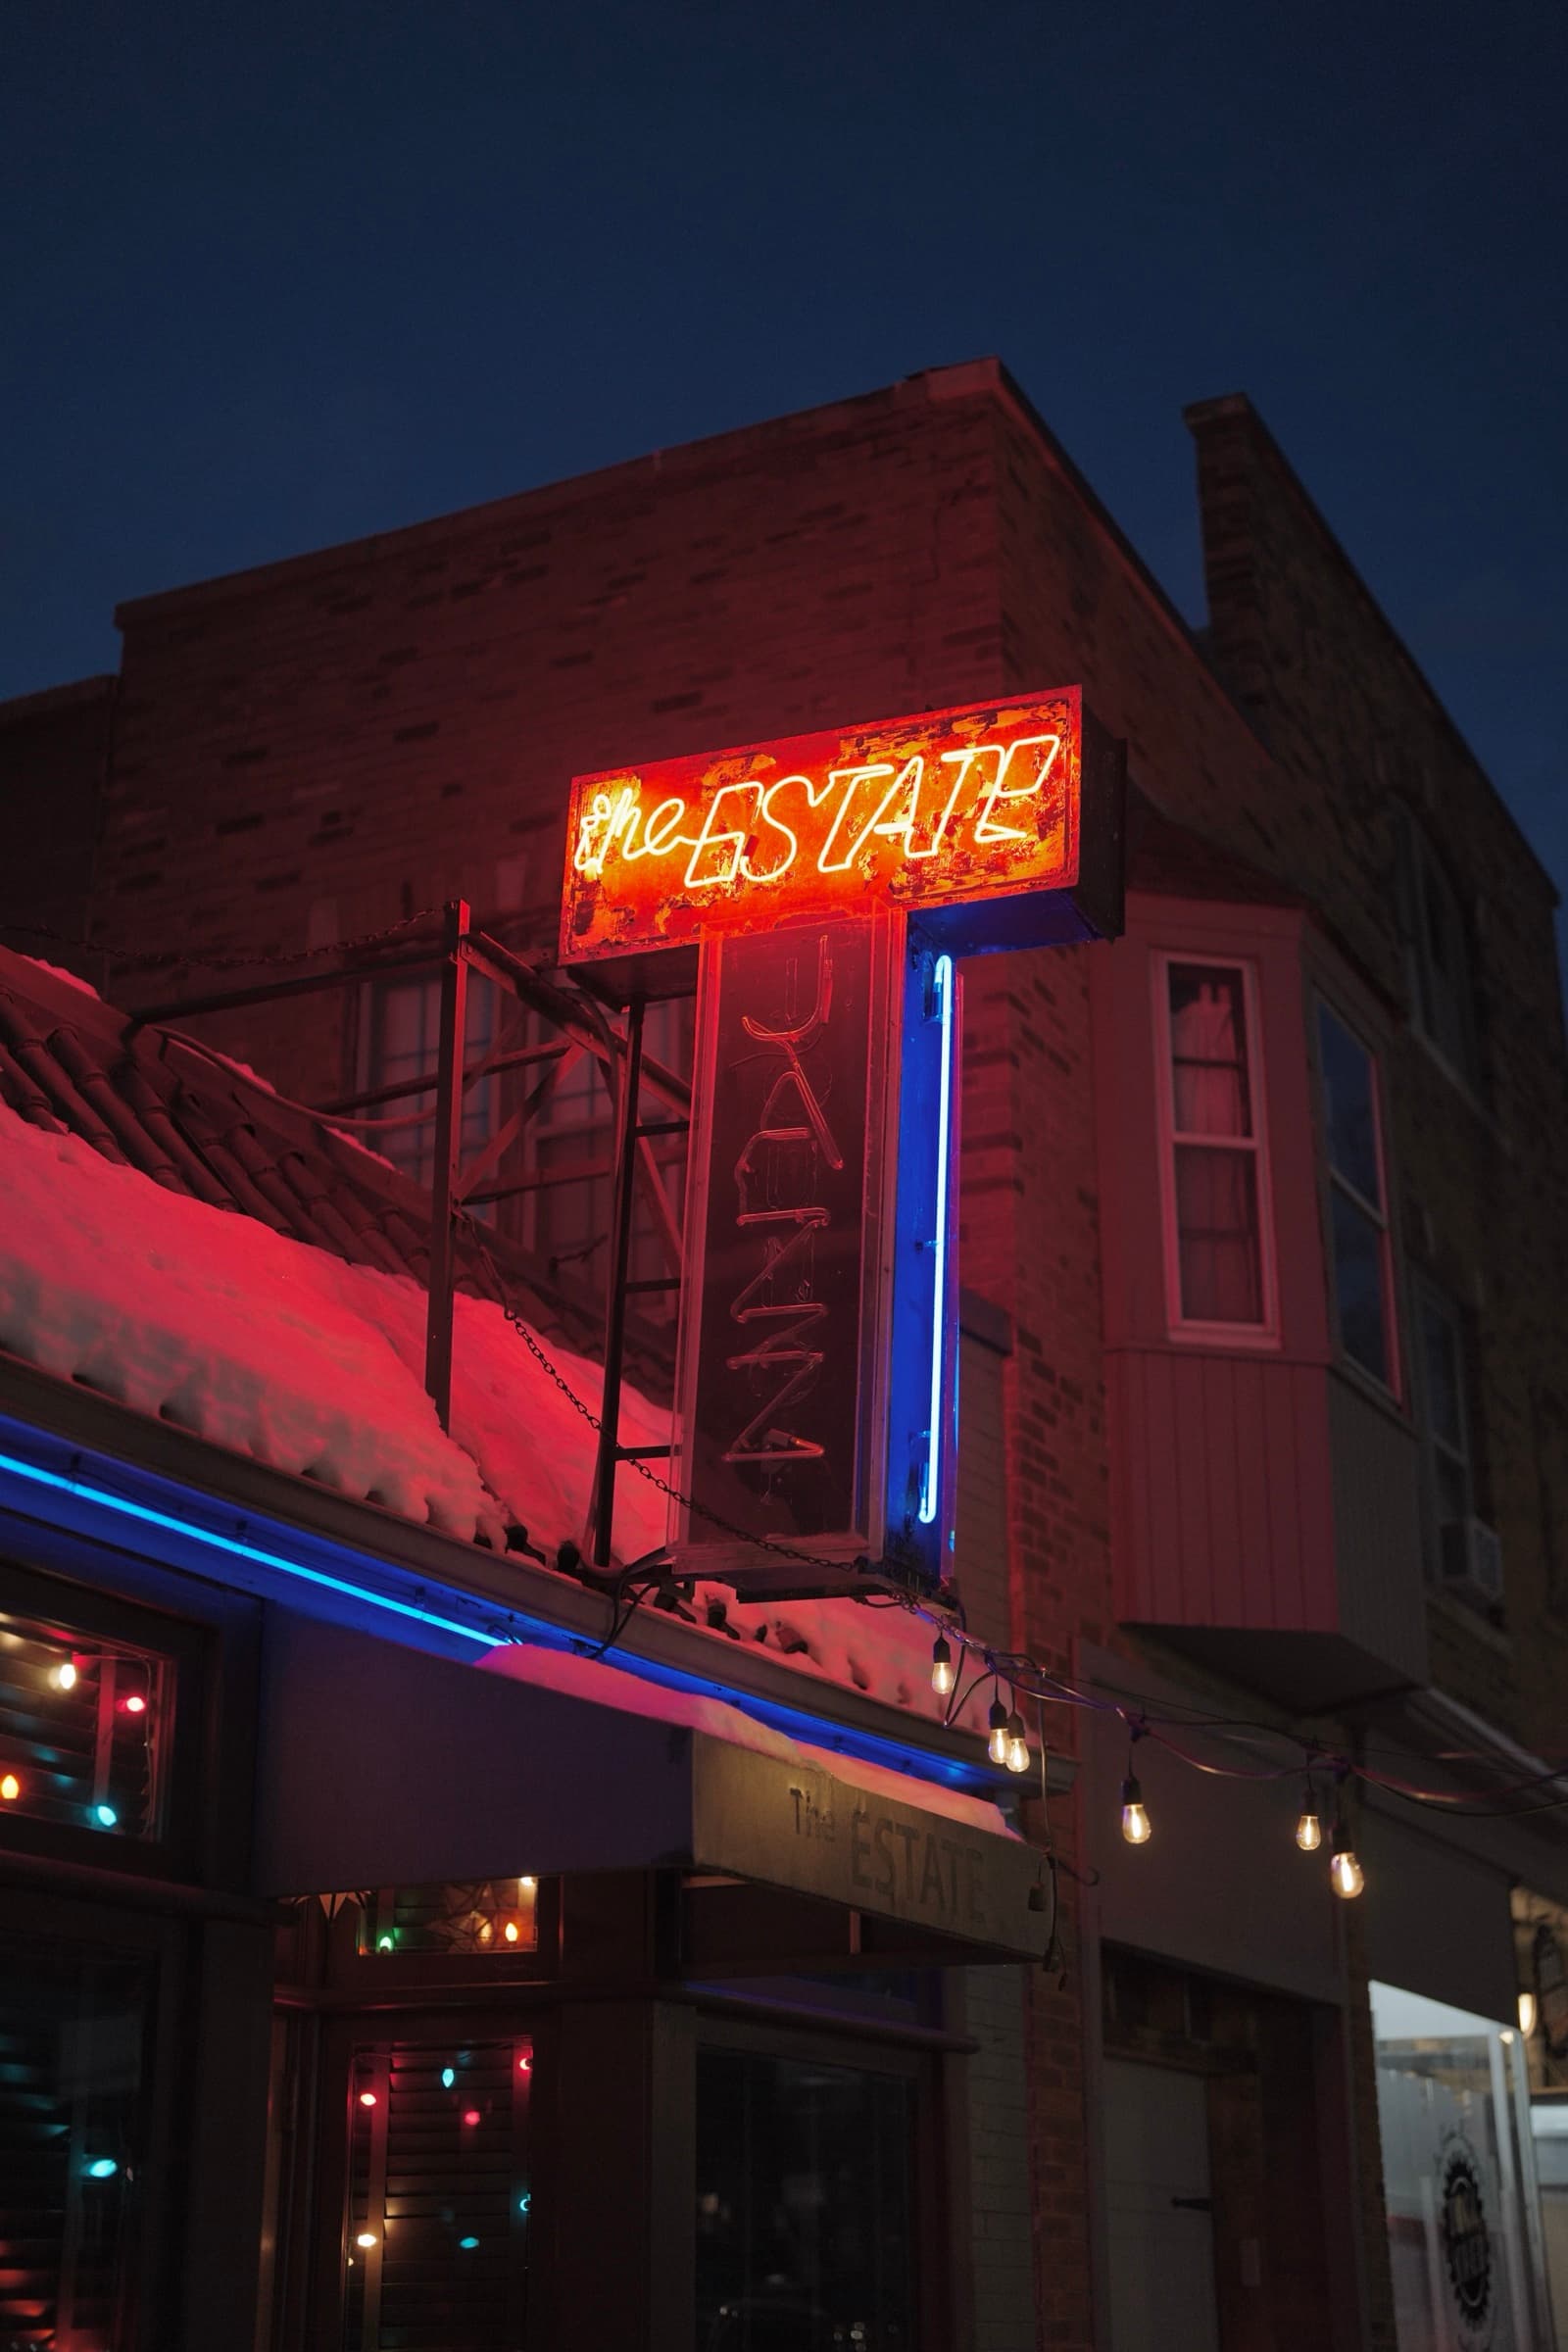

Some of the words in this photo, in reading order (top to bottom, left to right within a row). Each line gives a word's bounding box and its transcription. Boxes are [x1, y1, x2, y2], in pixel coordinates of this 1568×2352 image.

[573, 787, 687, 875] the
[684, 734, 1060, 889] ESTATE
[852, 1806, 986, 1923] ESTATE
